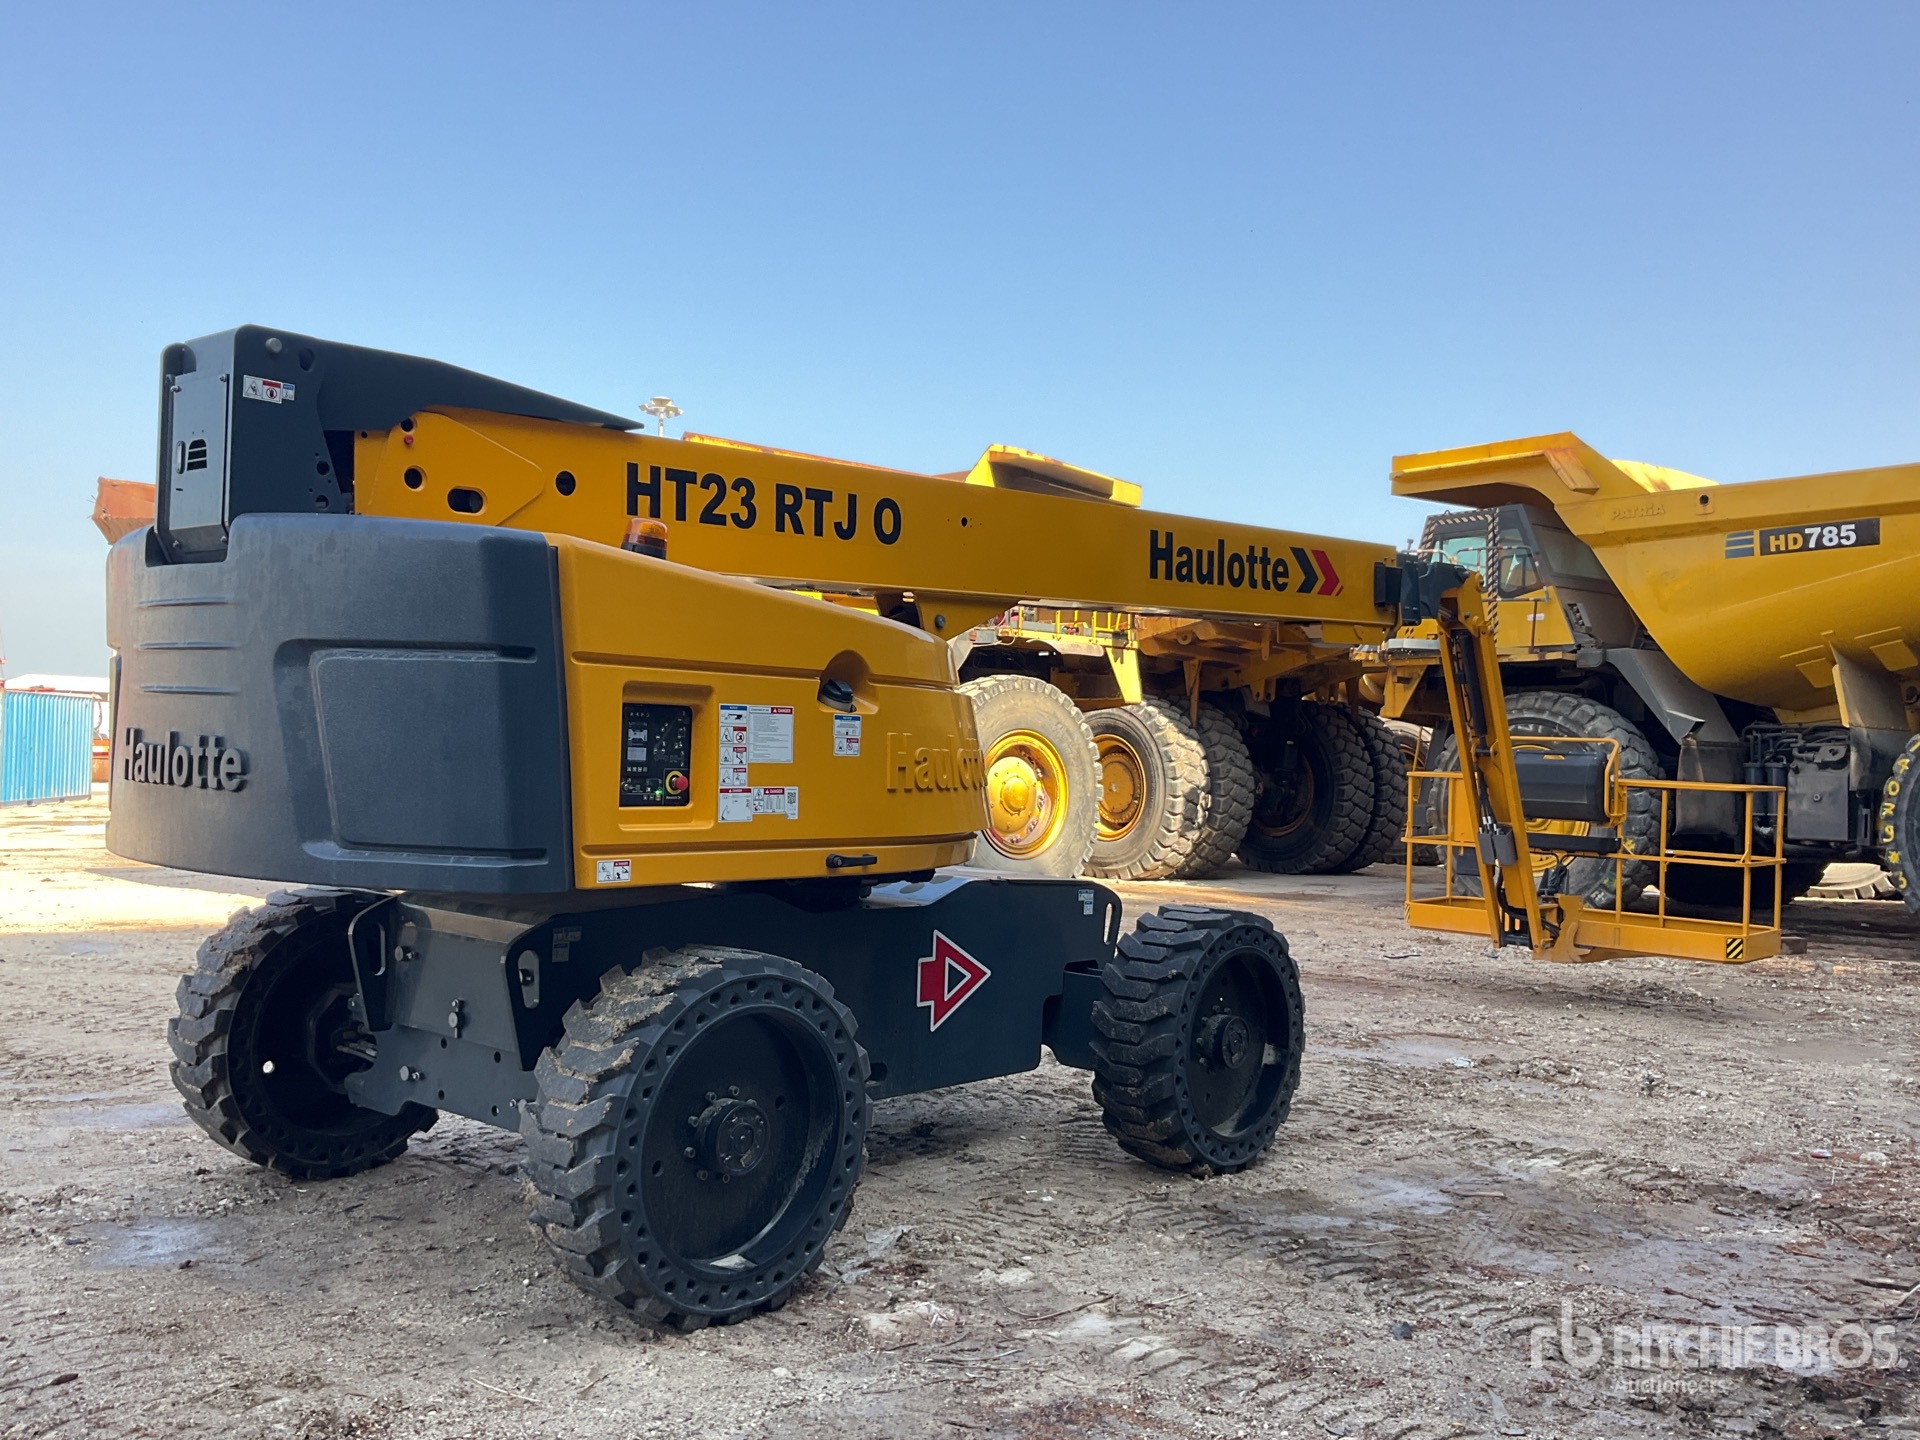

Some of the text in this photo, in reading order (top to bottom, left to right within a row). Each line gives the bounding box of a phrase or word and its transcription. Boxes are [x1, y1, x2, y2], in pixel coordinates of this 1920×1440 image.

[626, 462, 757, 530] HT23
[775, 483, 857, 540] RTJ
[1149, 529, 1289, 592] Haulotte
[124, 728, 249, 792] Haulotte
